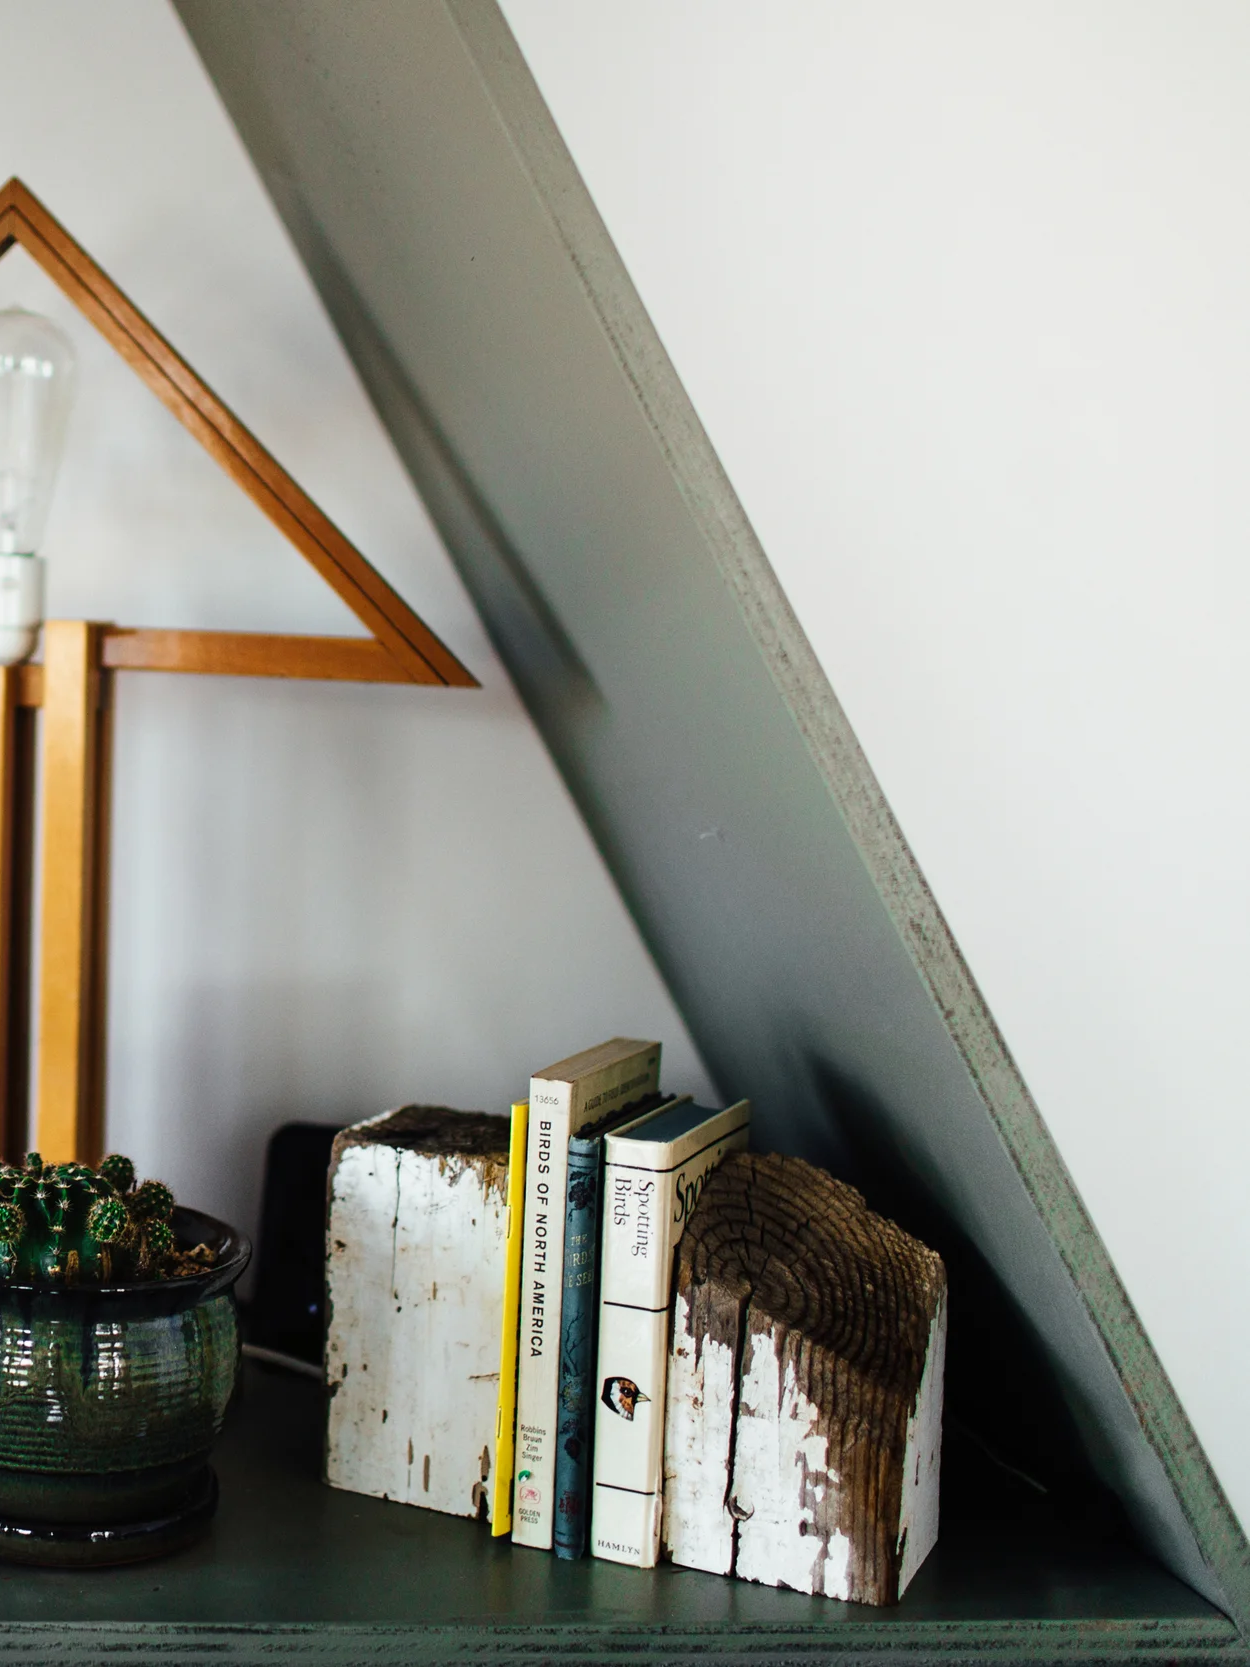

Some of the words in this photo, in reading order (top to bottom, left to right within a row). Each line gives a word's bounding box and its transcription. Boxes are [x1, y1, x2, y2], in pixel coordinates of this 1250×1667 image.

[535, 1094, 560, 1106] 13656
[537, 1120, 552, 1174] BIRDS
[536, 1182, 549, 1206] OF
[613, 1177, 632, 1226] Birds
[631, 1179, 656, 1259] Spotting
[533, 1213, 548, 1273] NORTH
[571, 1233, 588, 1247] THE
[530, 1280, 545, 1358] AMERICA
[520, 1424, 547, 1436] Robbins
[526, 1444, 539, 1452] Zim
[521, 1452, 543, 1462] Singer
[518, 1508, 541, 1518] GOLDEN
[520, 1515, 539, 1524] PRESS
[597, 1539, 641, 1555] HAMLYN
